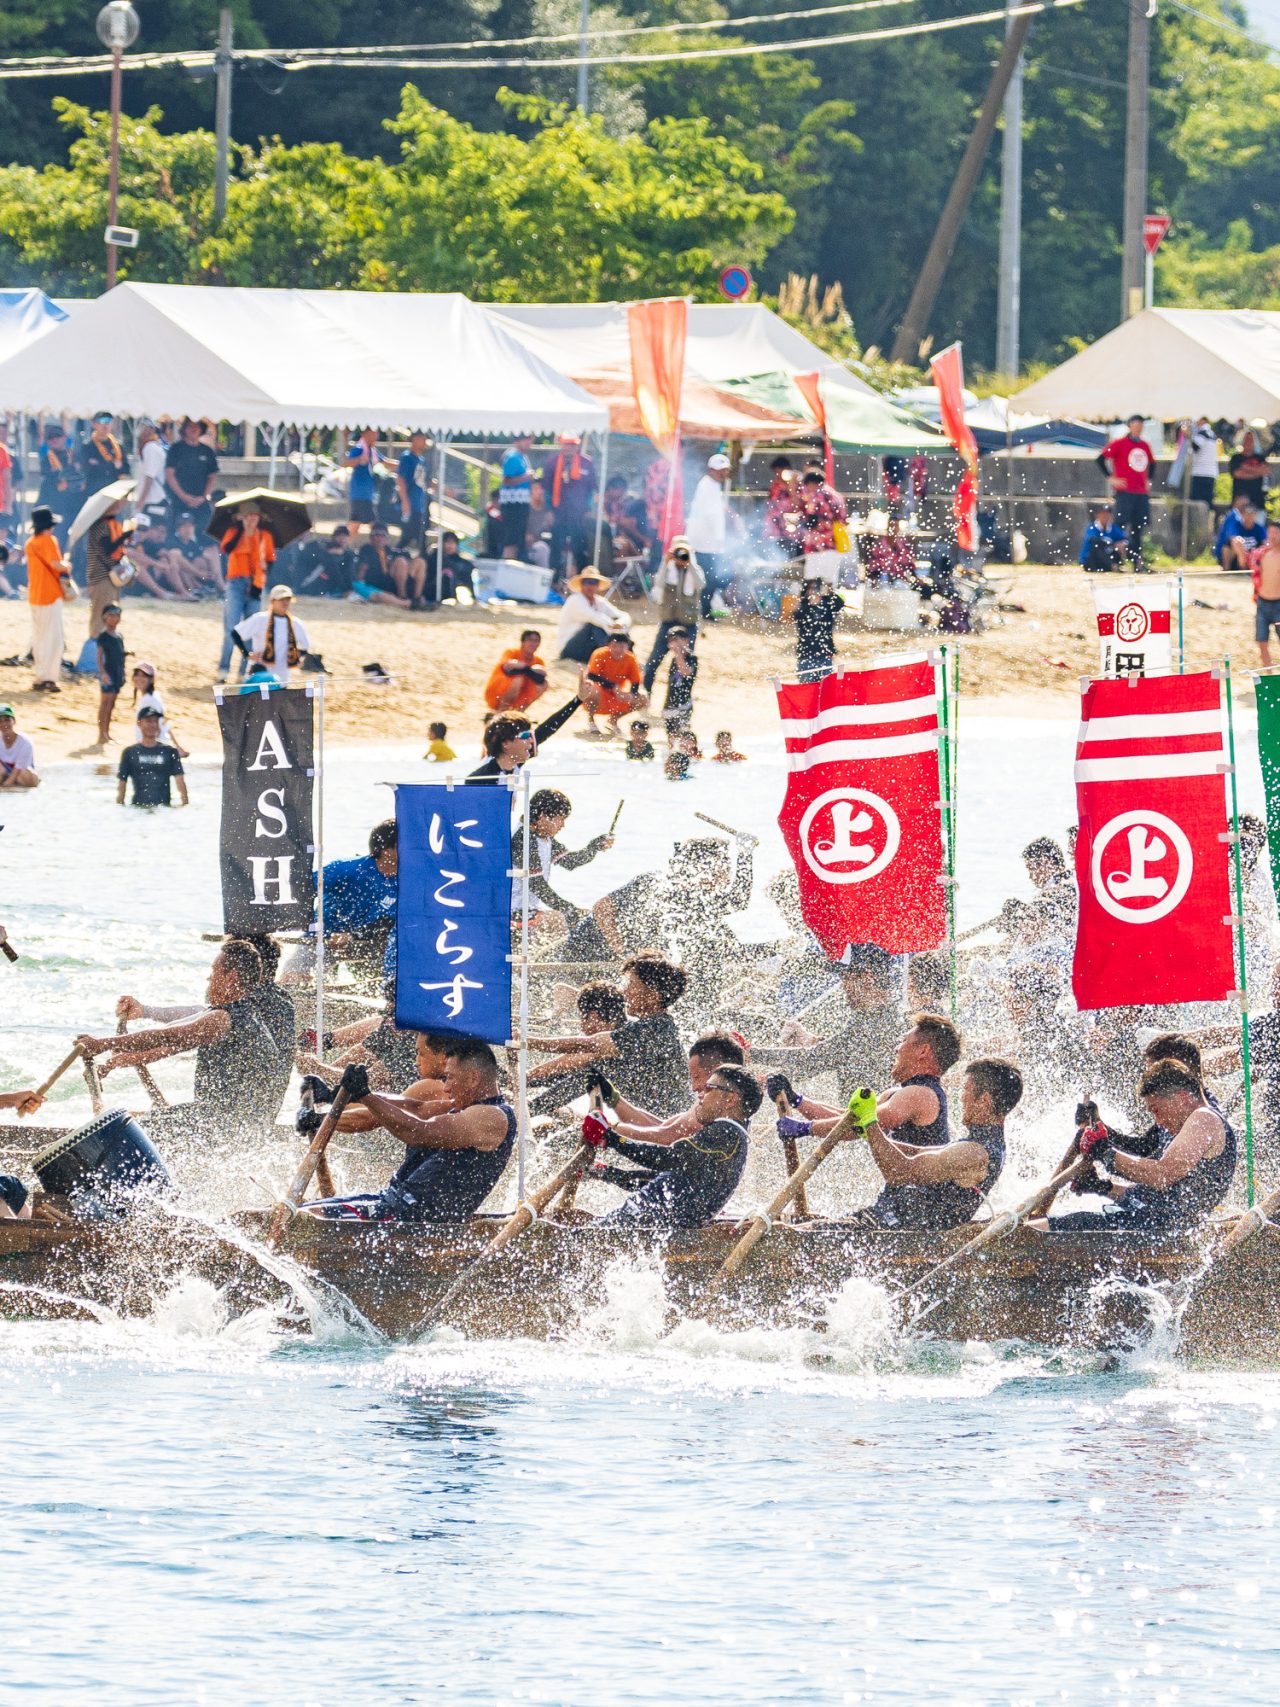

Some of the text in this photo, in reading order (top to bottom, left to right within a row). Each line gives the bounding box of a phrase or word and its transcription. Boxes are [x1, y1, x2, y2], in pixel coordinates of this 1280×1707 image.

[247, 720, 297, 905] ASH
[419, 813, 484, 1018] にこらす
